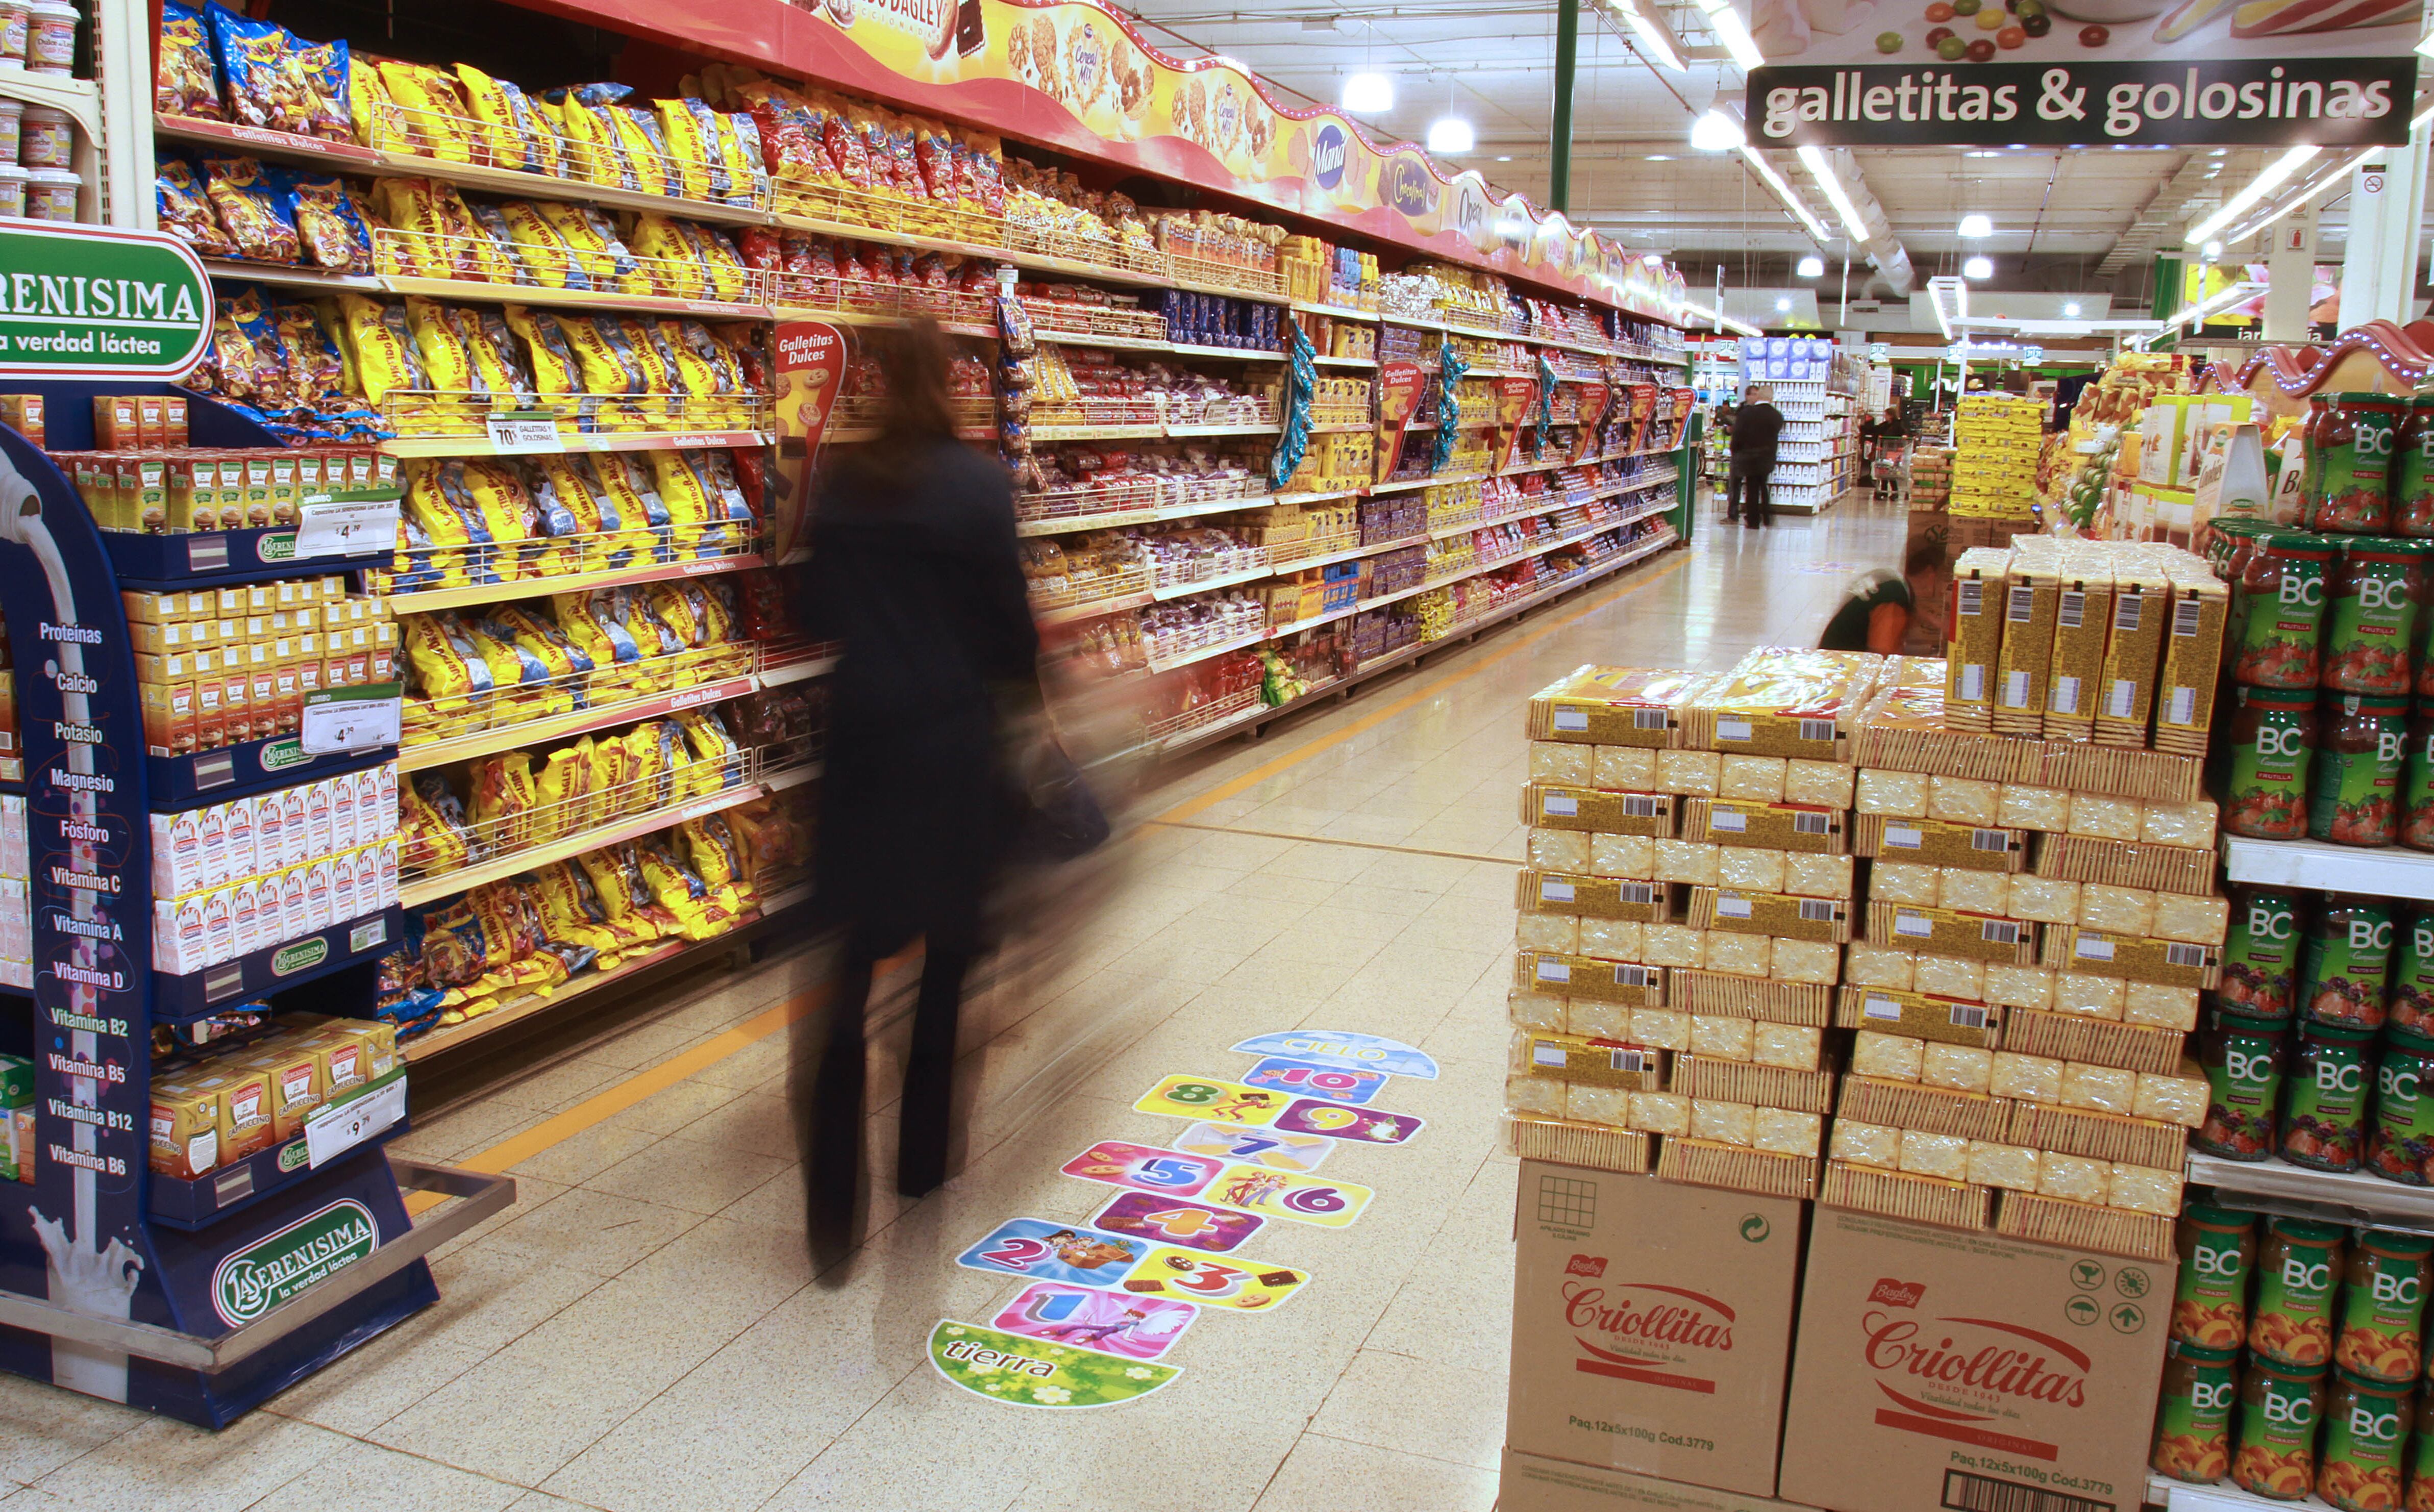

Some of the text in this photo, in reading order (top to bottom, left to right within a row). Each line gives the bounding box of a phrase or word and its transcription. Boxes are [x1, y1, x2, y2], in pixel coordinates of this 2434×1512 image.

[1076, 44, 1098, 68] Cereal
[1219, 101, 1237, 120] Cereal
[1763, 66, 2393, 139] galletitas & golosinas
[232, 128, 327, 152] Galletitas Dulces
[1314, 134, 1348, 184] Maná
[15, 330, 161, 355] verdad láctea
[779, 334, 834, 352] Galletitas
[788, 349, 825, 365] Dulces
[1385, 368, 1417, 377] Galletitas
[673, 436, 727, 447] Galletitas Dulces
[2354, 425, 2394, 455] BC
[341, 525, 350, 539] 4
[2278, 574, 2324, 607] BC
[2358, 577, 2409, 610] BC
[40, 622, 102, 644] Proteínas
[2279, 622, 2312, 631] FRUTILLA
[2361, 626, 2396, 635] FRUTILLA
[57, 673, 97, 694] Calcio
[670, 689, 722, 708] Galletitas Dulces
[55, 722, 102, 744] Potasio
[337, 729, 345, 743] 4
[2255, 725, 2303, 757] BC
[2376, 732, 2409, 762] BC
[51, 768, 114, 792] Magnesio
[60, 820, 109, 843] Fósforo
[52, 867, 121, 893] Vitamina C
[54, 914, 123, 941] Vitamina A
[2248, 907, 2294, 940] BC
[2348, 920, 2393, 950] BC
[54, 961, 123, 988] Vitamina D
[51, 1007, 129, 1037] Vitamina B2
[1282, 1036, 1387, 1062] CIELO
[48, 1052, 126, 1082] Vitamina B5
[1281, 1067, 1360, 1091] 10
[2226, 1051, 2273, 1082] BC
[2316, 1061, 2362, 1092] BC
[327, 1074, 366, 1097] CAPPUCCINO
[1165, 1083, 1226, 1106] 8
[2378, 1065, 2420, 1102] BC
[48, 1098, 133, 1131] Vitamina B12
[279, 1094, 321, 1117] CAPPUCCINO
[1299, 1107, 1357, 1130] 9
[228, 1114, 270, 1139] CAPPUCCINO
[352, 1122, 360, 1136] 9
[49, 1143, 126, 1176] Vitamina B6
[1231, 1136, 1278, 1157] 7
[1134, 1158, 1204, 1186] 5
[1283, 1187, 1346, 1215] 6
[1145, 1208, 1217, 1239] 4
[983, 1237, 1052, 1270] 2
[1571, 1259, 1602, 1274] Bagley
[2194, 1244, 2242, 1276] BC
[279, 1252, 358, 1299] la verdad láctea
[1175, 1262, 1246, 1297] 3
[2282, 1258, 2331, 1291] BC
[2372, 1272, 2421, 1304] BC
[1876, 1284, 1919, 1304] Bagley
[1562, 1280, 1733, 1351] Criollitas
[1614, 1335, 1645, 1345] DESDE
[942, 1340, 1057, 1379] tierra
[1862, 1310, 2085, 1408] Criollitas
[1928, 1381, 1969, 1396] DESDE
[2191, 1381, 2233, 1408] BC
[2264, 1391, 2313, 1424] BC
[1569, 1415, 1715, 1451] Paq.12x5x100g Cod.3779
[2349, 1406, 2400, 1441] BC
[1950, 1450, 2114, 1496] Paq.12x5x100g Cod.3779
